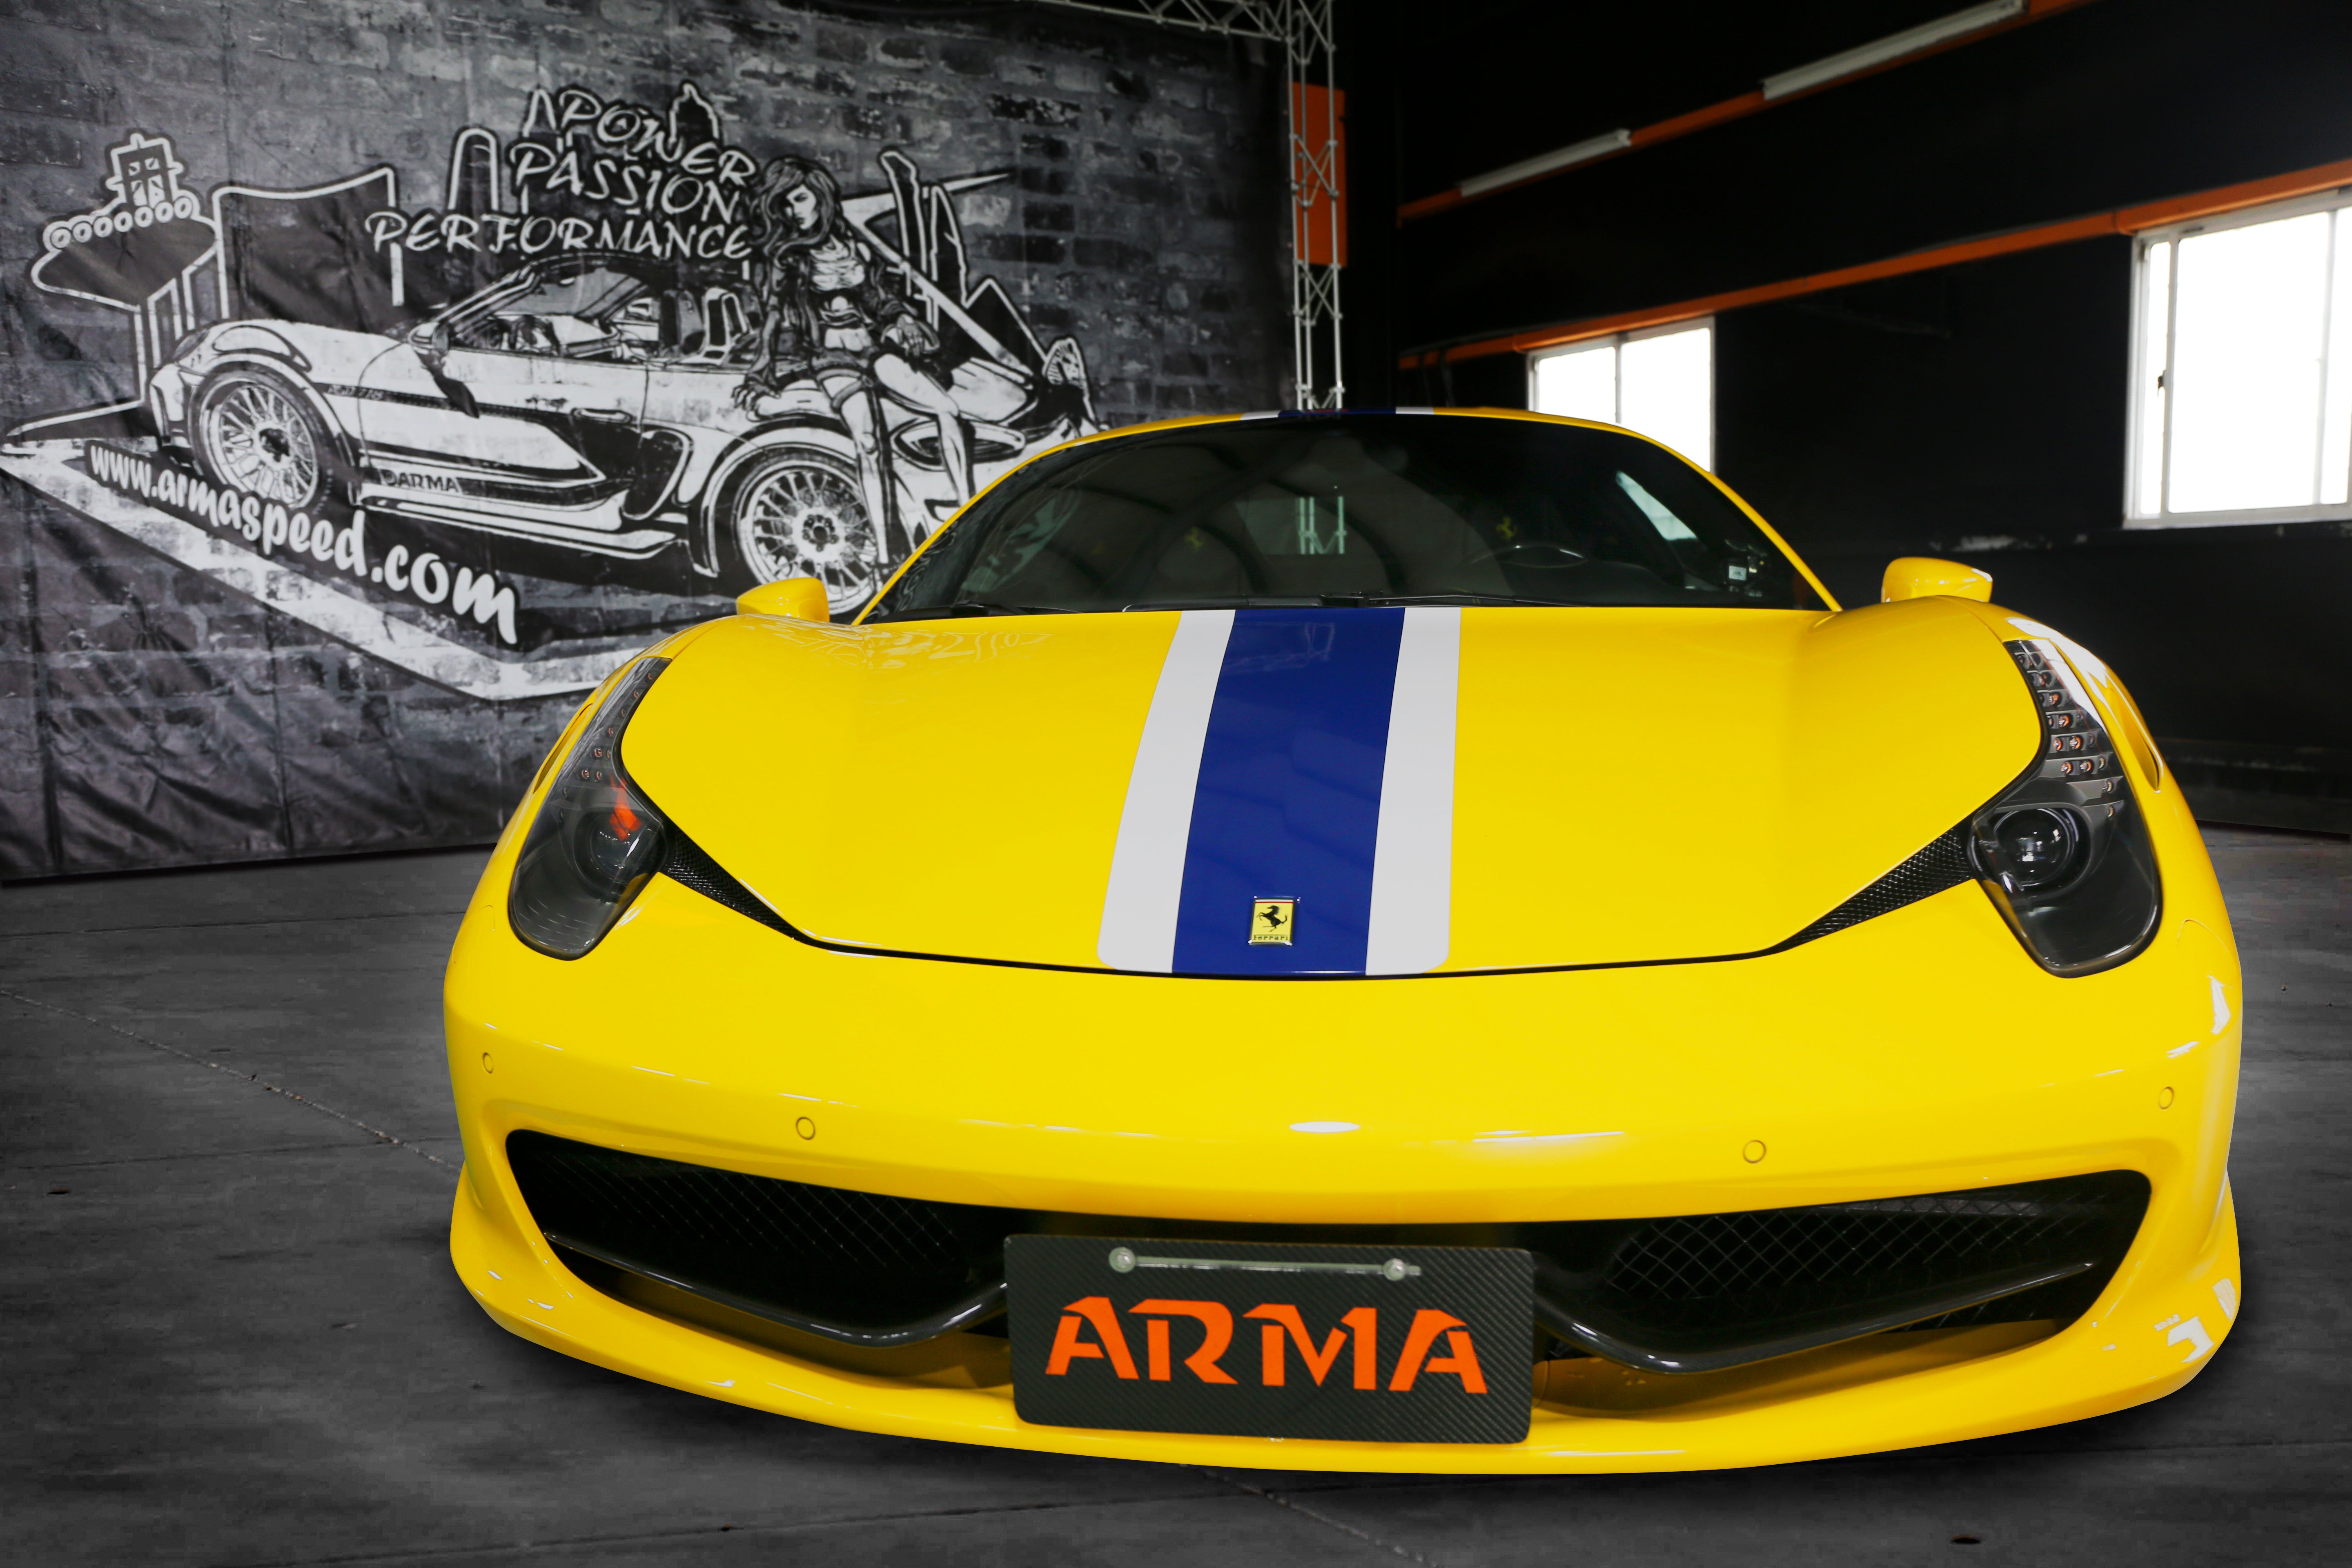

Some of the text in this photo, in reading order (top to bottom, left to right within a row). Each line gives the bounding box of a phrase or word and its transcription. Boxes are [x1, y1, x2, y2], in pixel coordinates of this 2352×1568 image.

[510, 142, 741, 225] PASSION
[365, 211, 752, 259] PERFORMANCE
[90, 445, 518, 644] www.armaspeed.com
[1045, 1296, 1488, 1394] ARMA
